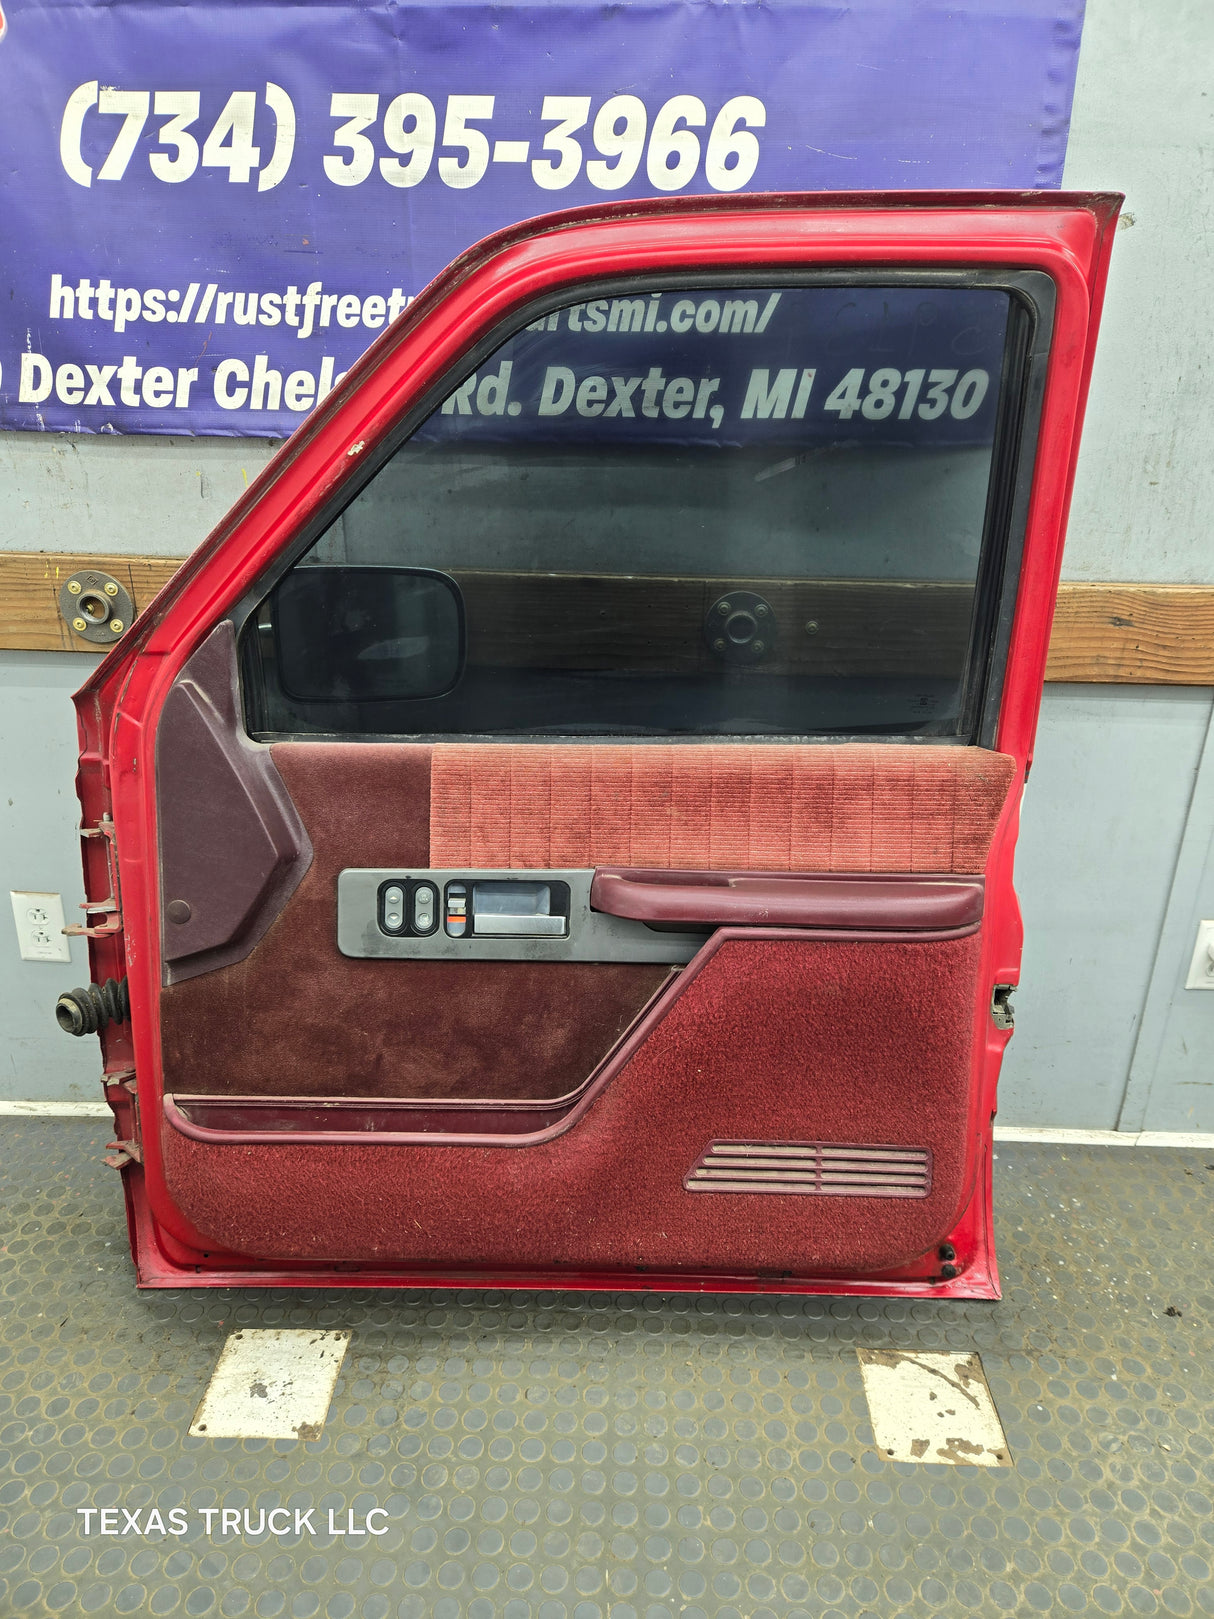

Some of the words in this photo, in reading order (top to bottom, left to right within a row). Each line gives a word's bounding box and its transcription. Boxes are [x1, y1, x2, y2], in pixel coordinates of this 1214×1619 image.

[60, 80, 296, 192] (734)
[323, 92, 767, 192] 395-3966
[18, 351, 199, 408] Dexter
[213, 354, 347, 412] Chel
[440, 360, 522, 416] Rd.
[538, 366, 725, 428] Dexter,
[739, 368, 817, 419] MI
[823, 368, 990, 420] 48130
